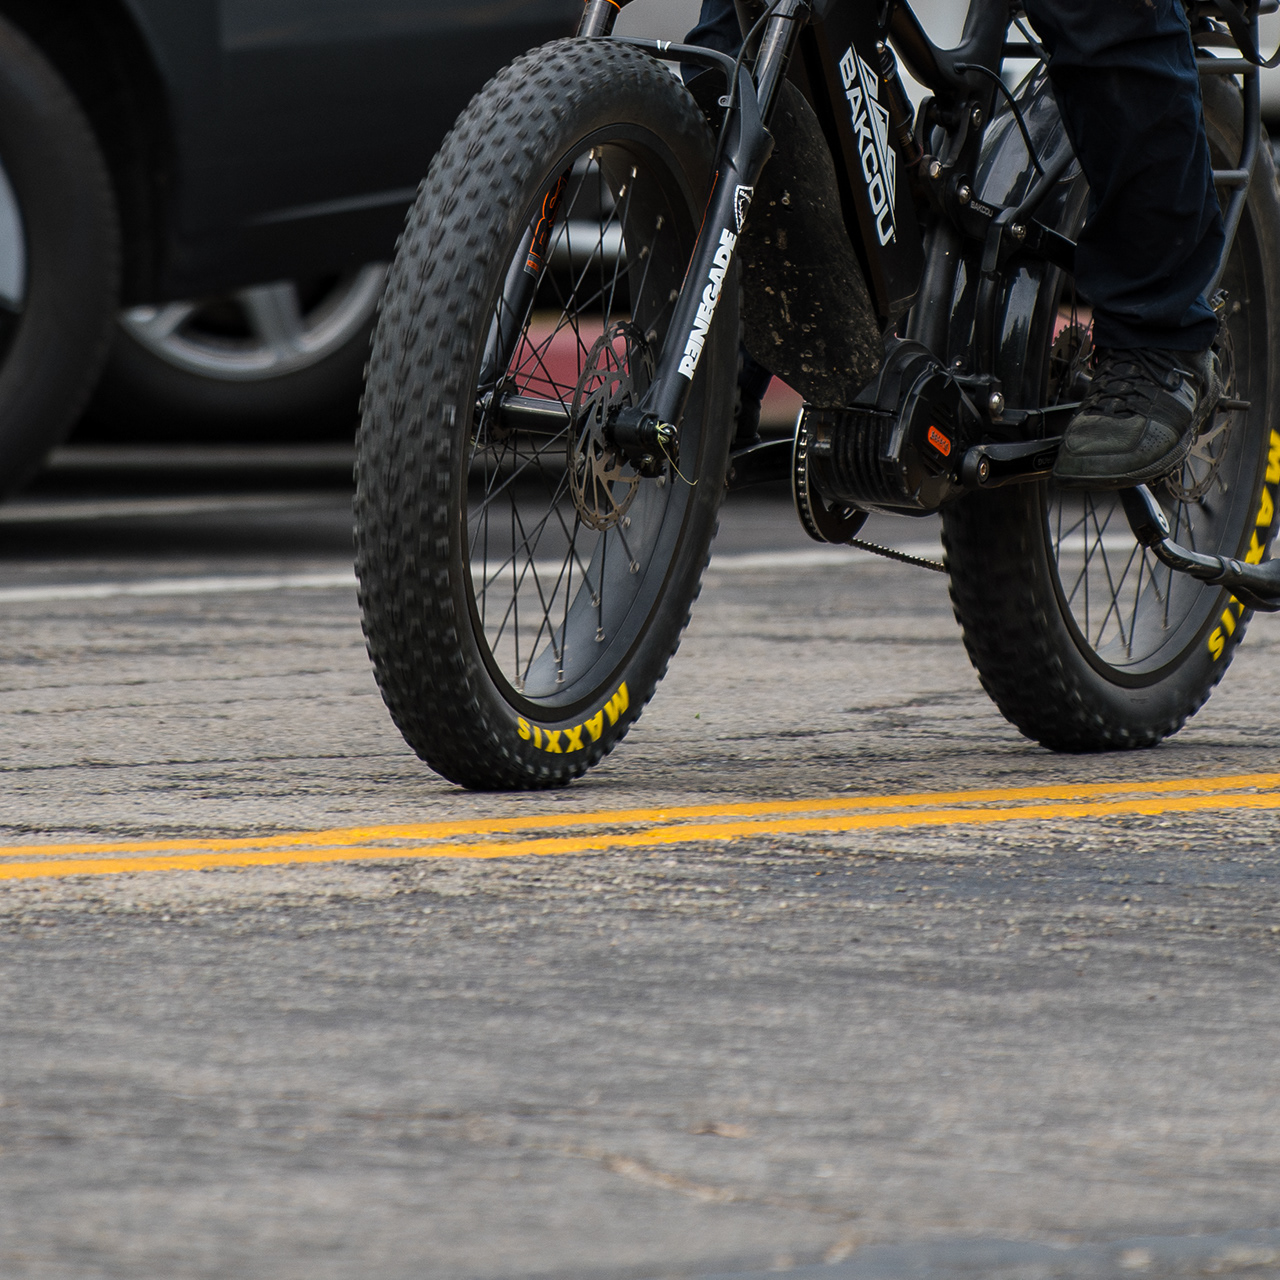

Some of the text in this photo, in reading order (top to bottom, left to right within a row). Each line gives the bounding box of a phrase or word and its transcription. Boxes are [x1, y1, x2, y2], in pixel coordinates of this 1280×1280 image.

[839, 46, 895, 247] BAKCOU
[678, 227, 738, 380] RENEGADE
[517, 680, 630, 754] MAXXIS
